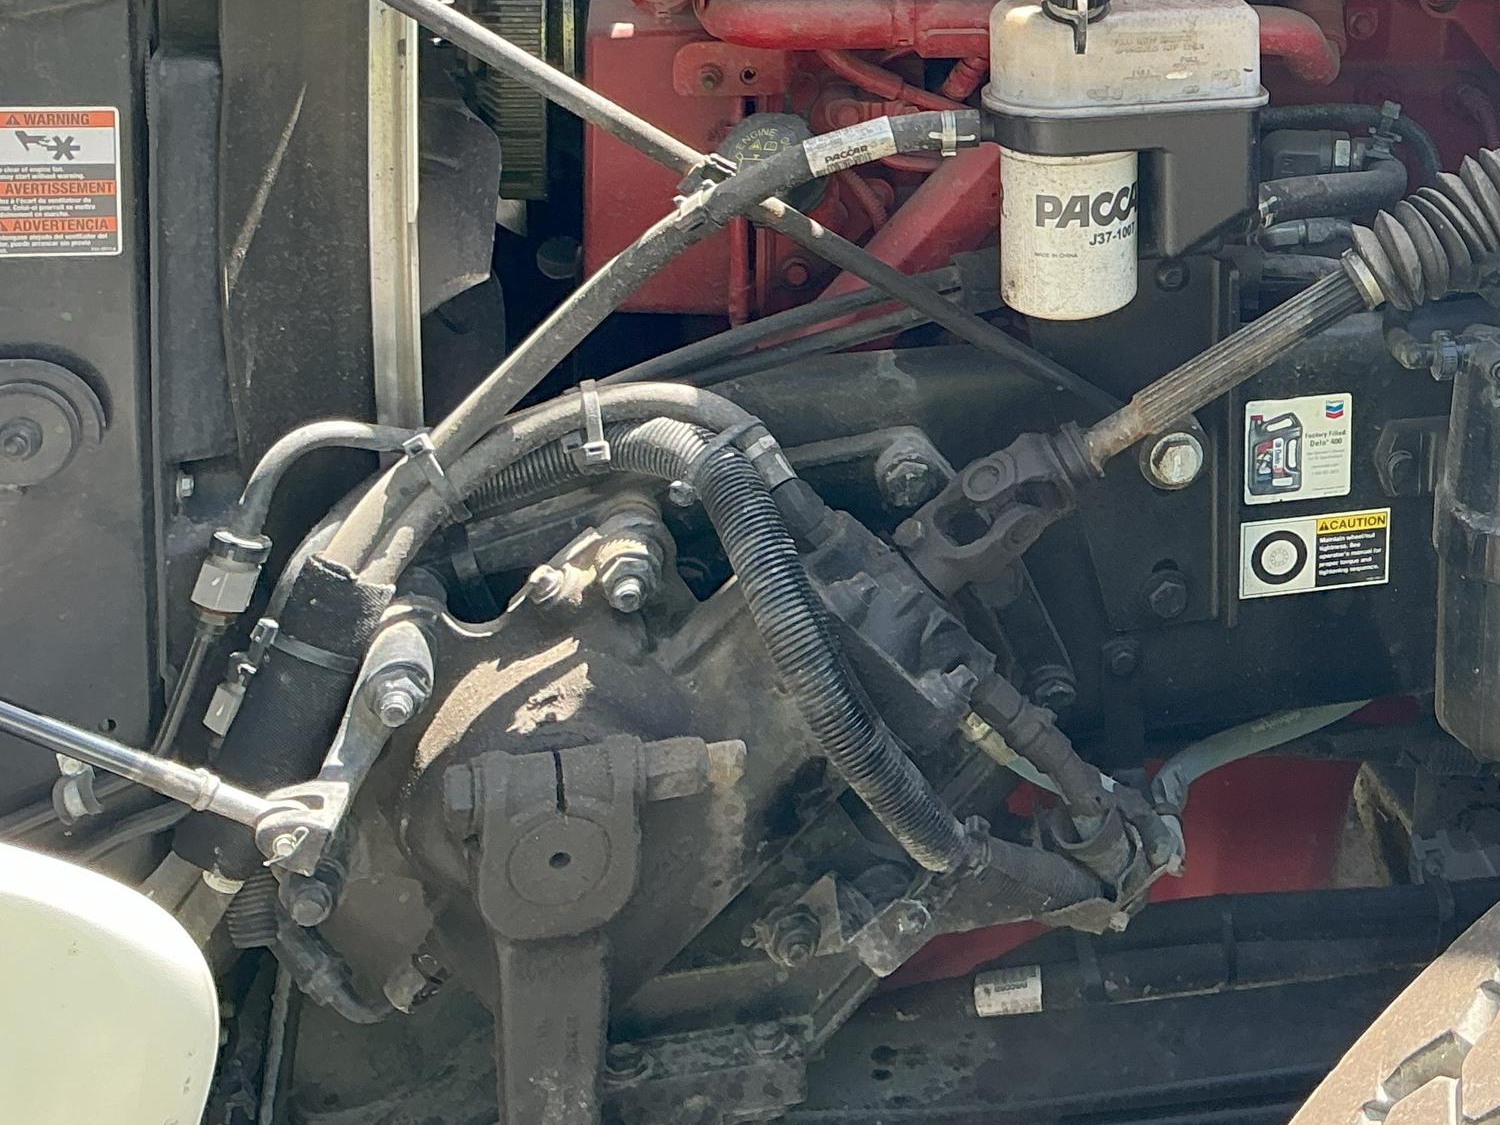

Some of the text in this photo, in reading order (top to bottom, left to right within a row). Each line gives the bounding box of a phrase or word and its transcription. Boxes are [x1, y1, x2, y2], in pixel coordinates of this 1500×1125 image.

[23, 113, 90, 125] WARNING
[735, 127, 779, 152] ENGINE
[824, 144, 868, 164] PACCAR
[5, 181, 113, 195] AVERTISSEMENT
[1035, 181, 1138, 229] PACCA
[13, 218, 109, 232] ADVERTENCIA
[1329, 514, 1386, 531] CAUTION
